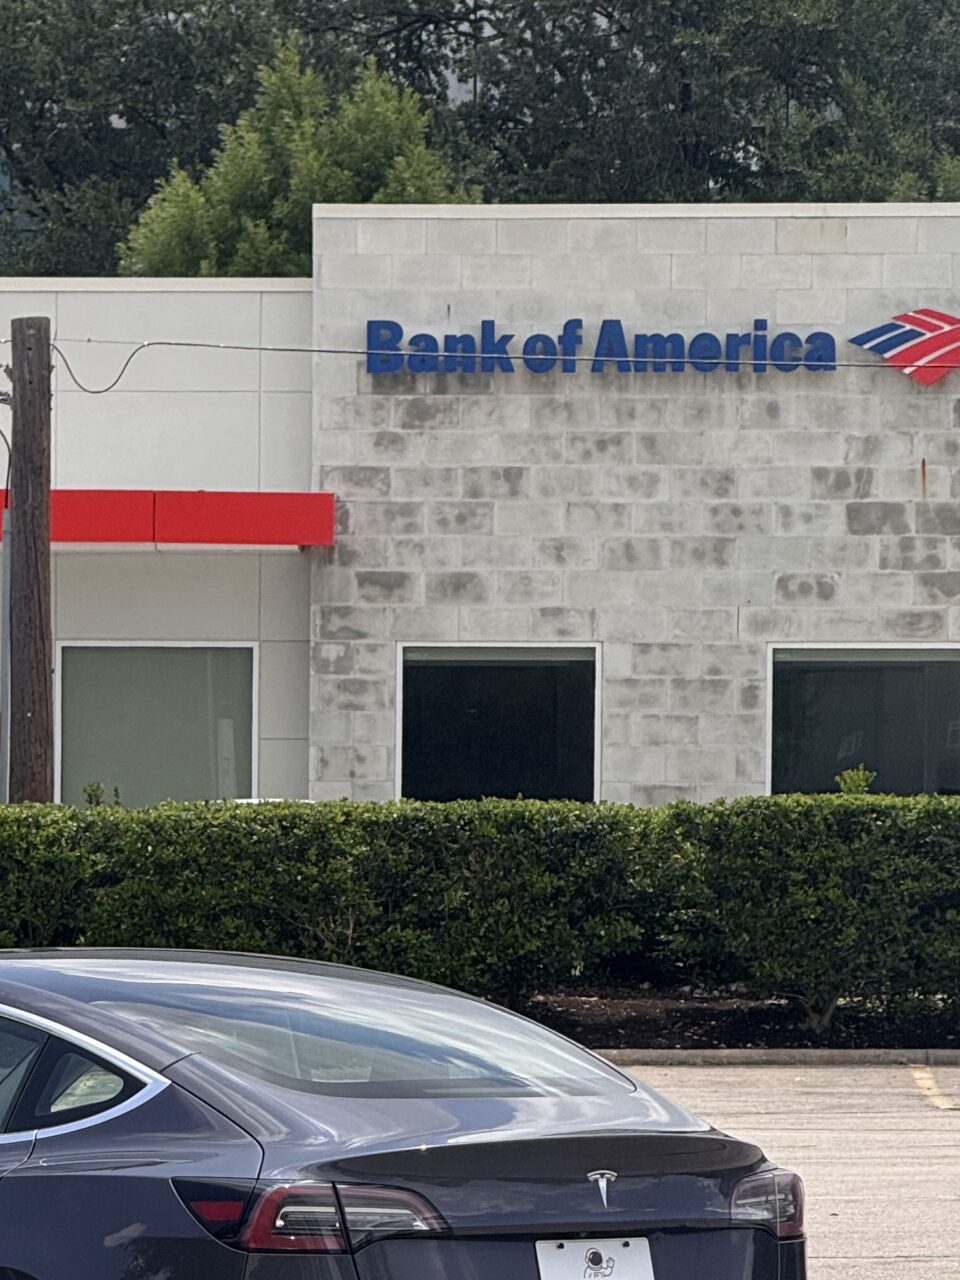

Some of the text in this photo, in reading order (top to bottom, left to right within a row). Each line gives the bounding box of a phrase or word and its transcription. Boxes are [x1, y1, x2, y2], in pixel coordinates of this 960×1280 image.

[366, 318, 837, 374] Bank of America
